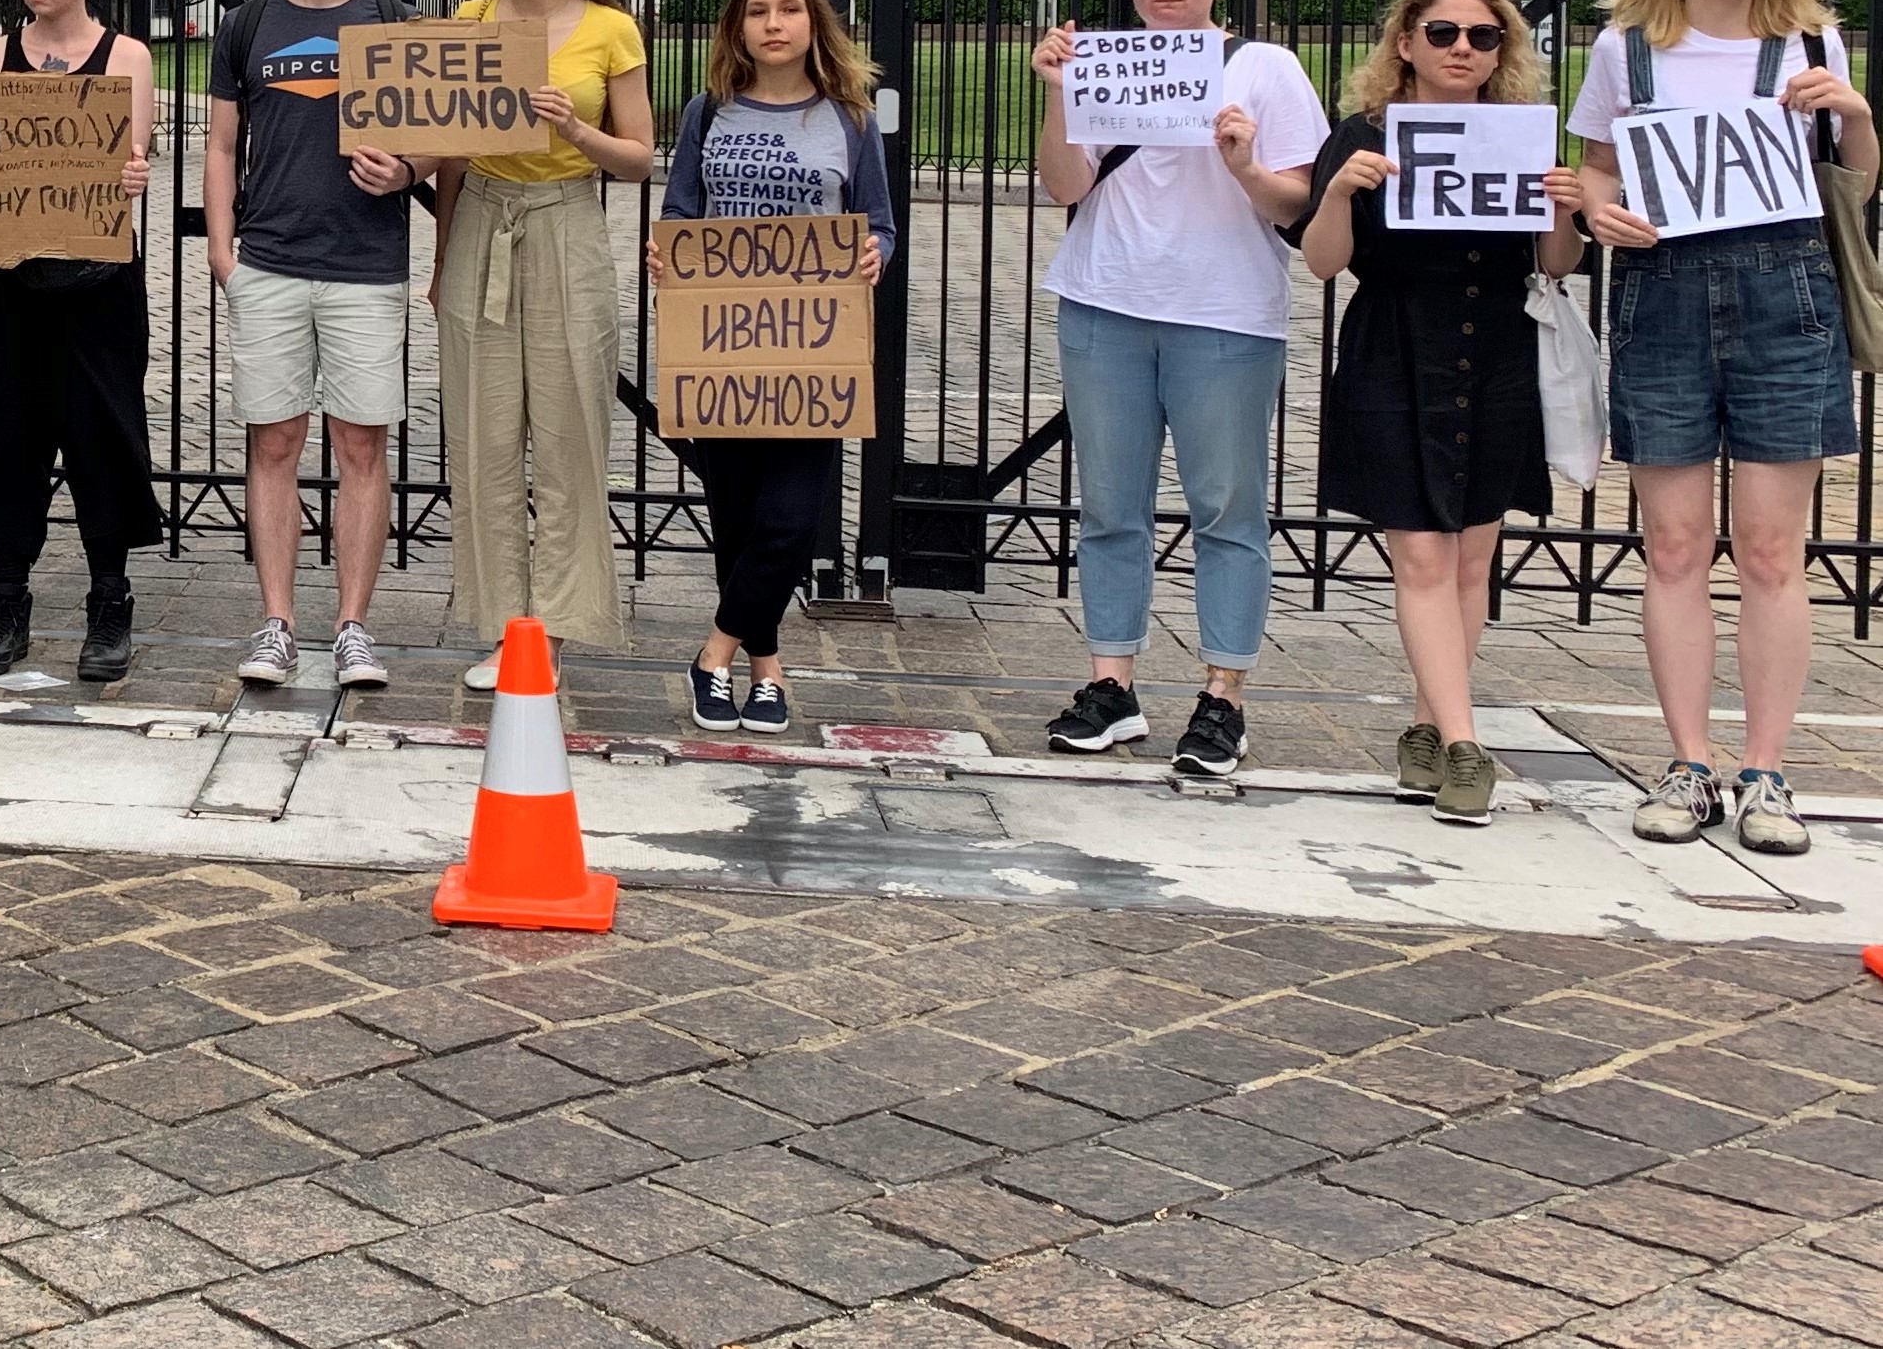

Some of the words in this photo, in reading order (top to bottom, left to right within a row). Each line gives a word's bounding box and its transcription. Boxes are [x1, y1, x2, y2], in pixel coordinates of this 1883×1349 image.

[365, 42, 503, 83] FREE
[1074, 33, 1204, 59] СВОБОДУ
[1074, 58, 1166, 81] ИВАНУ
[1074, 79, 1208, 107] ГОЛУНОВУ
[1089, 116, 1127, 130] FREE
[1627, 107, 1809, 228] IVAN
[92, 209, 127, 237] ВУ
[670, 219, 859, 284] СВОБОДУ
[702, 297, 838, 353] ИВАНУ
[675, 374, 857, 429] ГОЛУНОВУ
